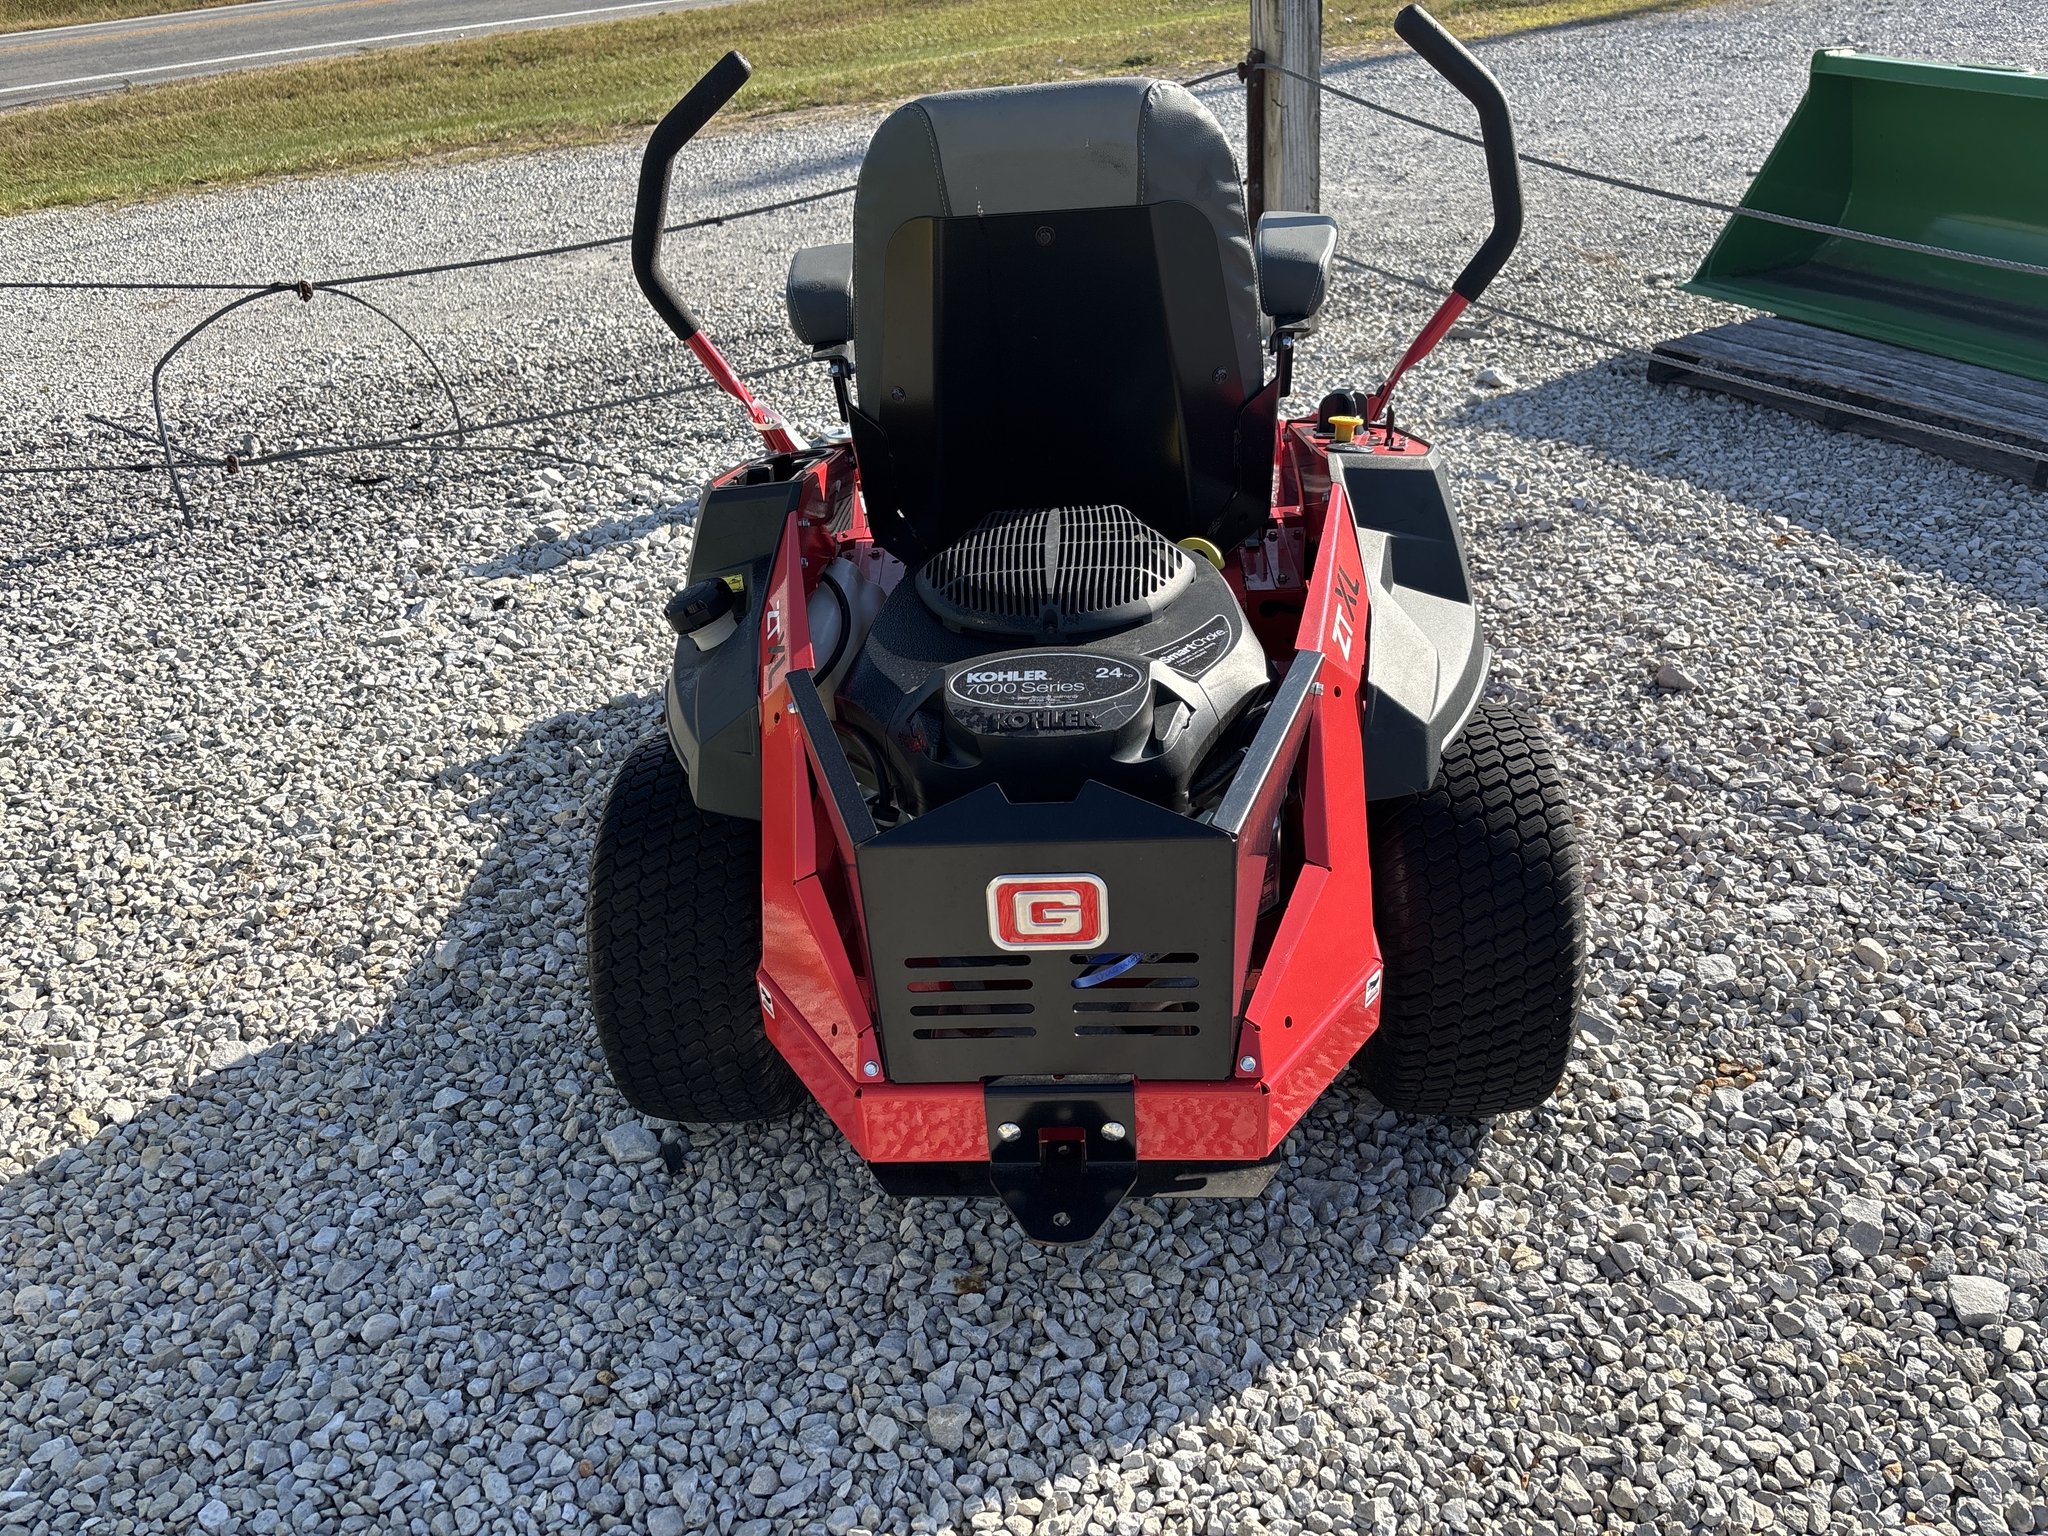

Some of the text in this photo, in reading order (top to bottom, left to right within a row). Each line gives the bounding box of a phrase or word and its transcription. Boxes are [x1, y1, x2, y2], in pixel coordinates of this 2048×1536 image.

[1331, 564, 1361, 662] ZT XL
[966, 670, 1048, 684] KOHLER
[1095, 667, 1123, 679] 24
[965, 681, 1085, 695] 7000 Series
[995, 709, 1097, 729] KOHLER
[1012, 889, 1083, 935] G
